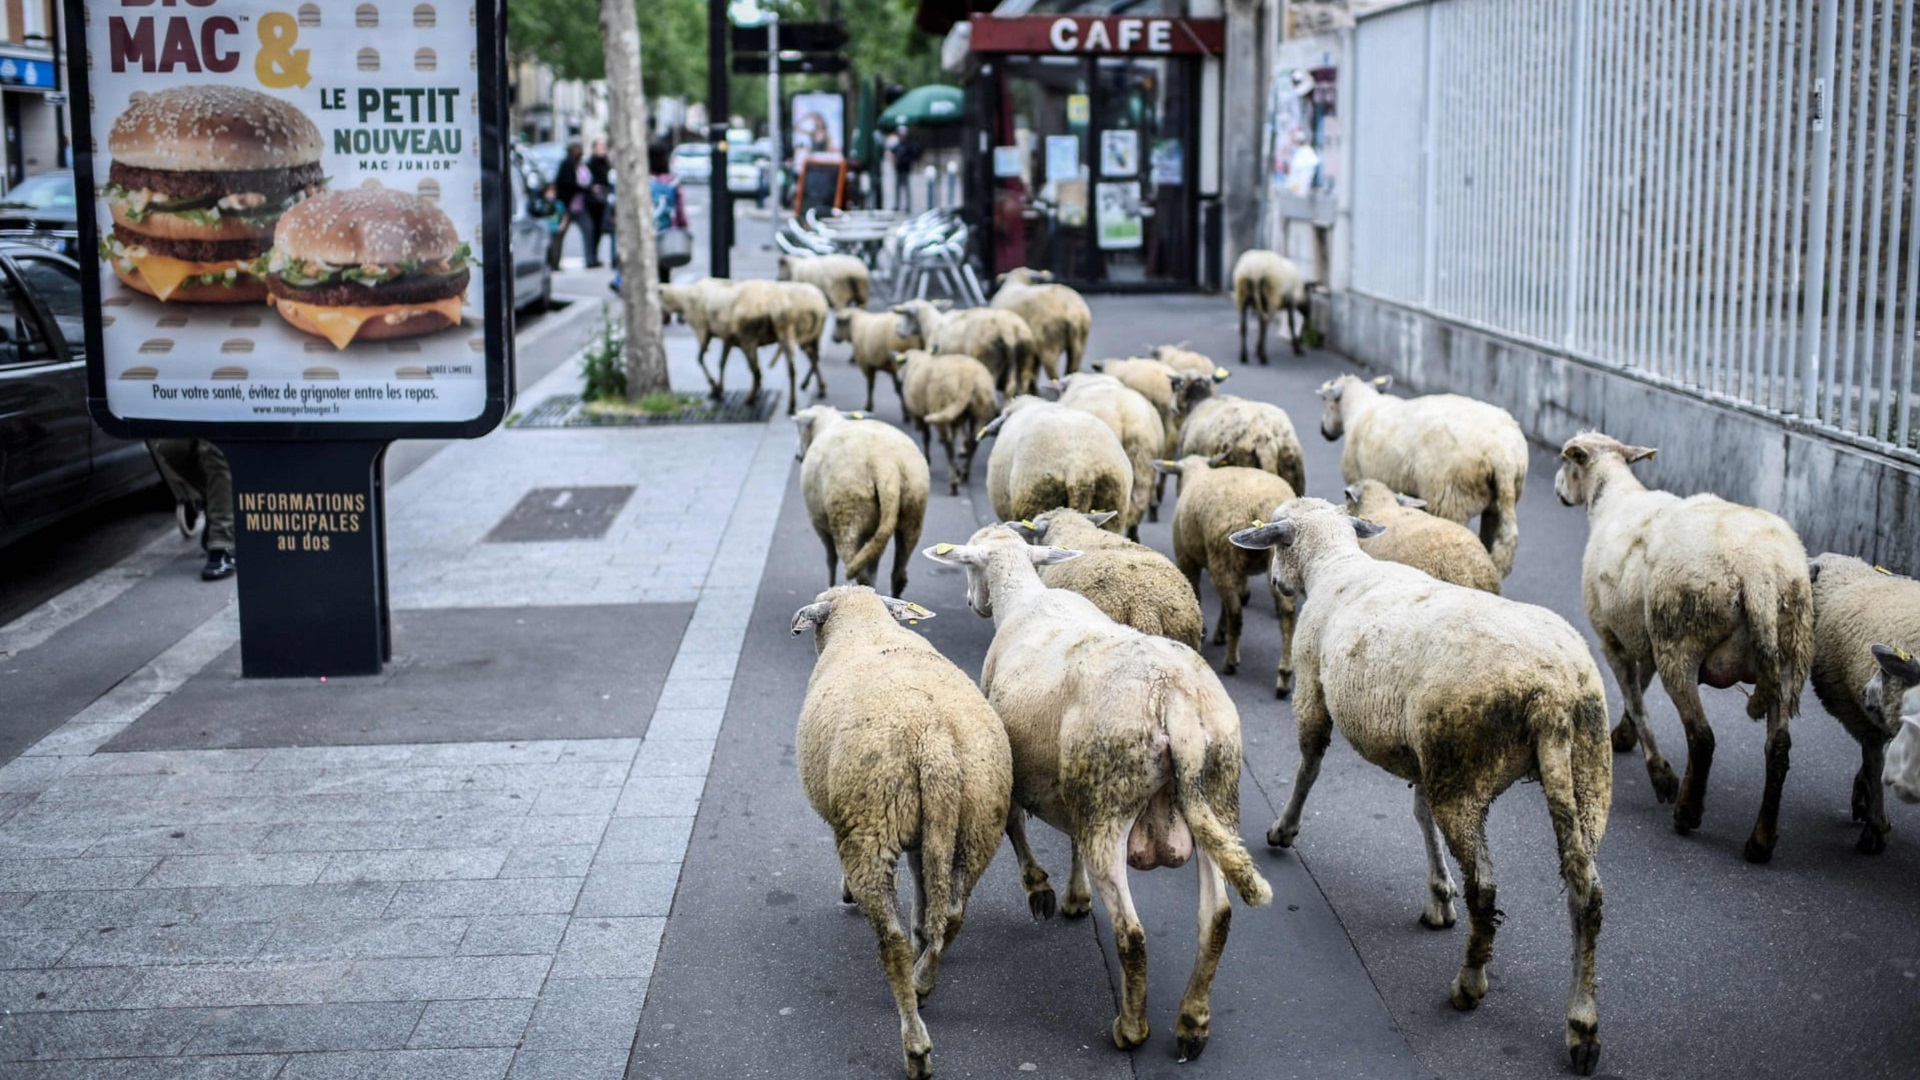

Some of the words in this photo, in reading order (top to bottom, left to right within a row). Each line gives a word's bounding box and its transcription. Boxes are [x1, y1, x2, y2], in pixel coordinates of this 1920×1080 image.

[1050, 17, 1172, 51] CAFE
[255, 11, 312, 90] &
[320, 88, 347, 110] LE
[358, 87, 460, 123] PETIT
[333, 128, 462, 155] NOUVEAU
[359, 160, 389, 170] MAC
[152, 384, 178, 399] Pour
[181, 385, 209, 399] votre
[212, 384, 245, 402] santé,
[248, 384, 280, 399] évitez
[283, 382, 297, 399] de
[300, 384, 351, 403] grignoter
[354, 385, 383, 399] entre
[386, 382, 401, 399] les
[405, 388, 439, 402] repas.
[253, 403, 340, 416] www.mangerbouger.fr
[239, 493, 365, 512] INFORMATIONS
[246, 513, 360, 532] MUNICIPALES
[278, 535, 296, 551] au
[302, 532, 330, 551] dos
